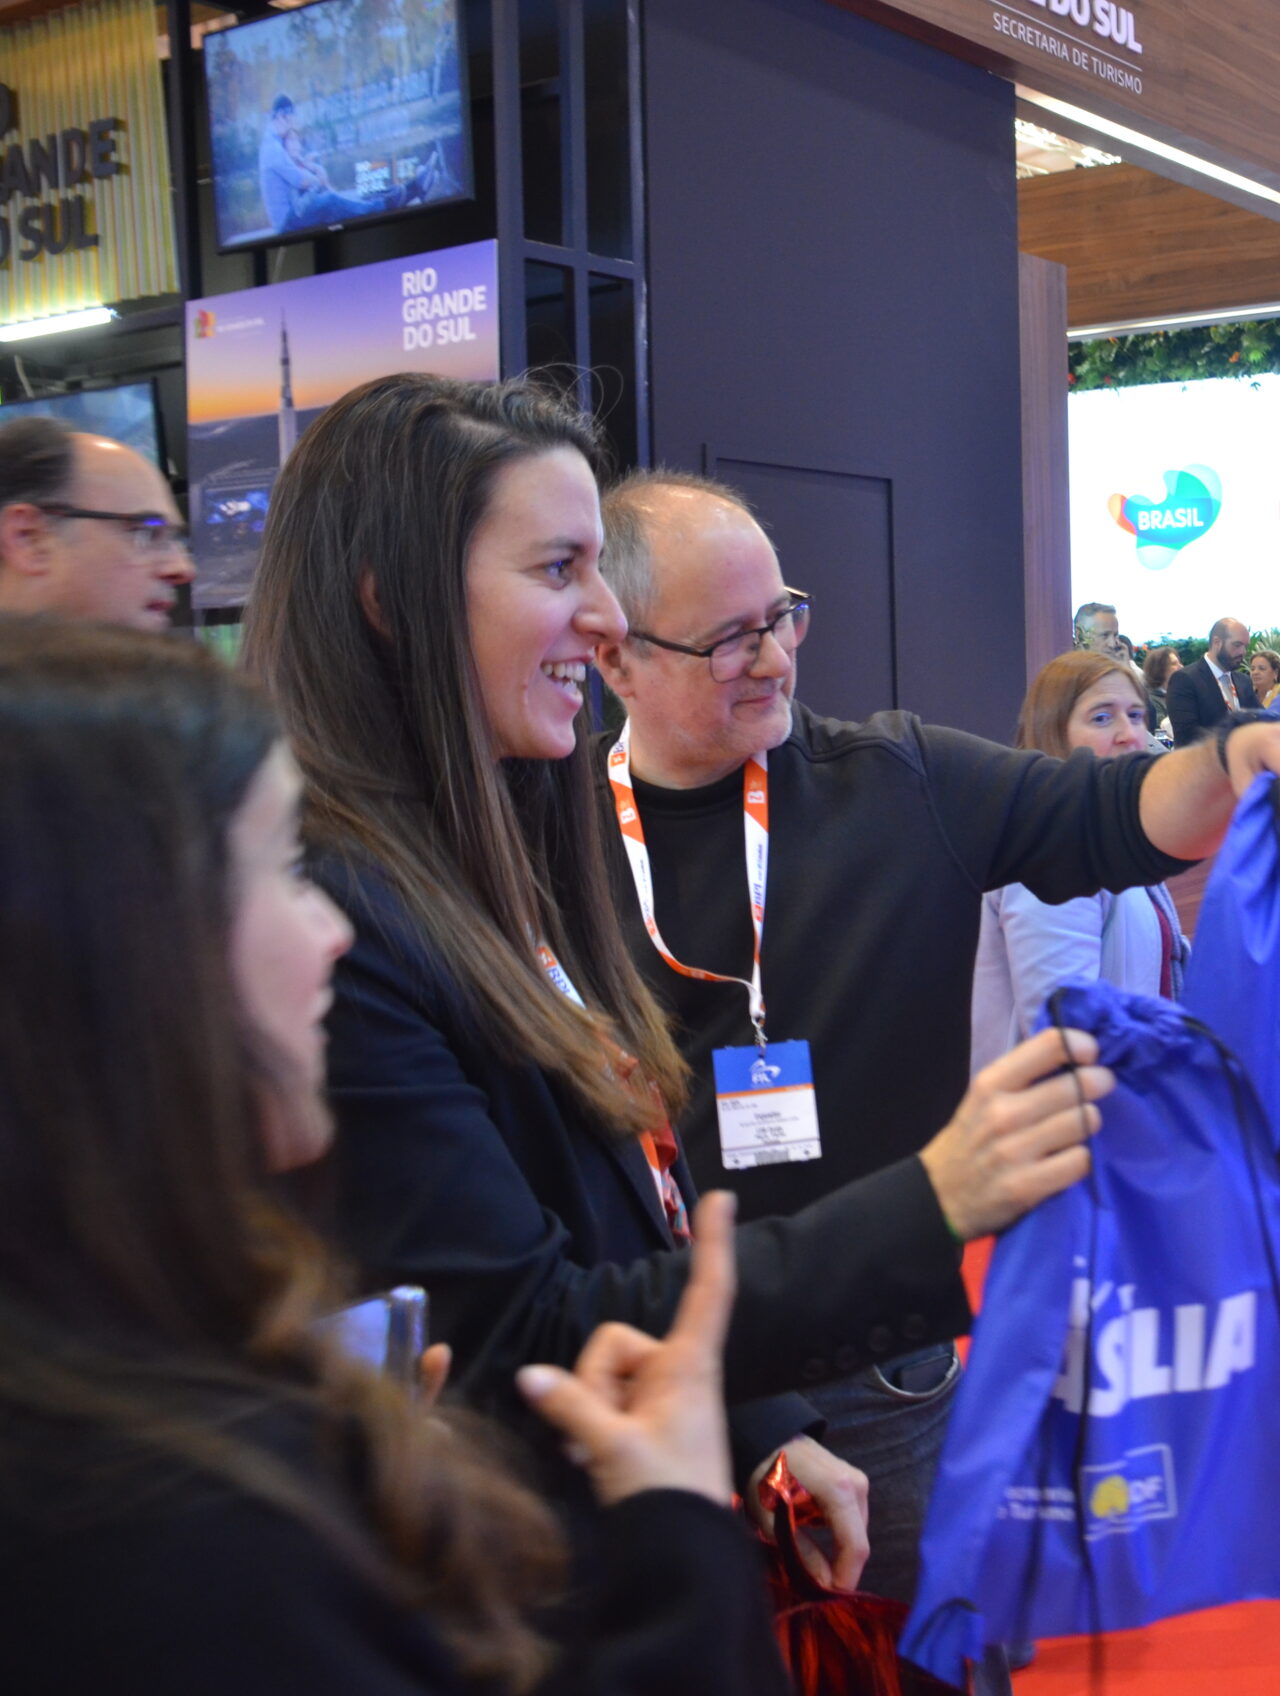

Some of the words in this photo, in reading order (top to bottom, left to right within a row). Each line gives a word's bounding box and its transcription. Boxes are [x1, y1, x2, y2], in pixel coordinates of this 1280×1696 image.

[1092, 0, 1143, 54] SUL
[992, 12, 1070, 62] SECRETARIA
[1072, 47, 1089, 71] DE
[1091, 56, 1143, 94] TURISMO
[0, 117, 122, 204] ANDE
[18, 195, 100, 261] SUL
[401, 267, 438, 298] RIO
[402, 285, 488, 324] GRANDE
[403, 324, 433, 351] DO
[436, 316, 477, 346] SUL
[1137, 507, 1205, 531] BRASIL
